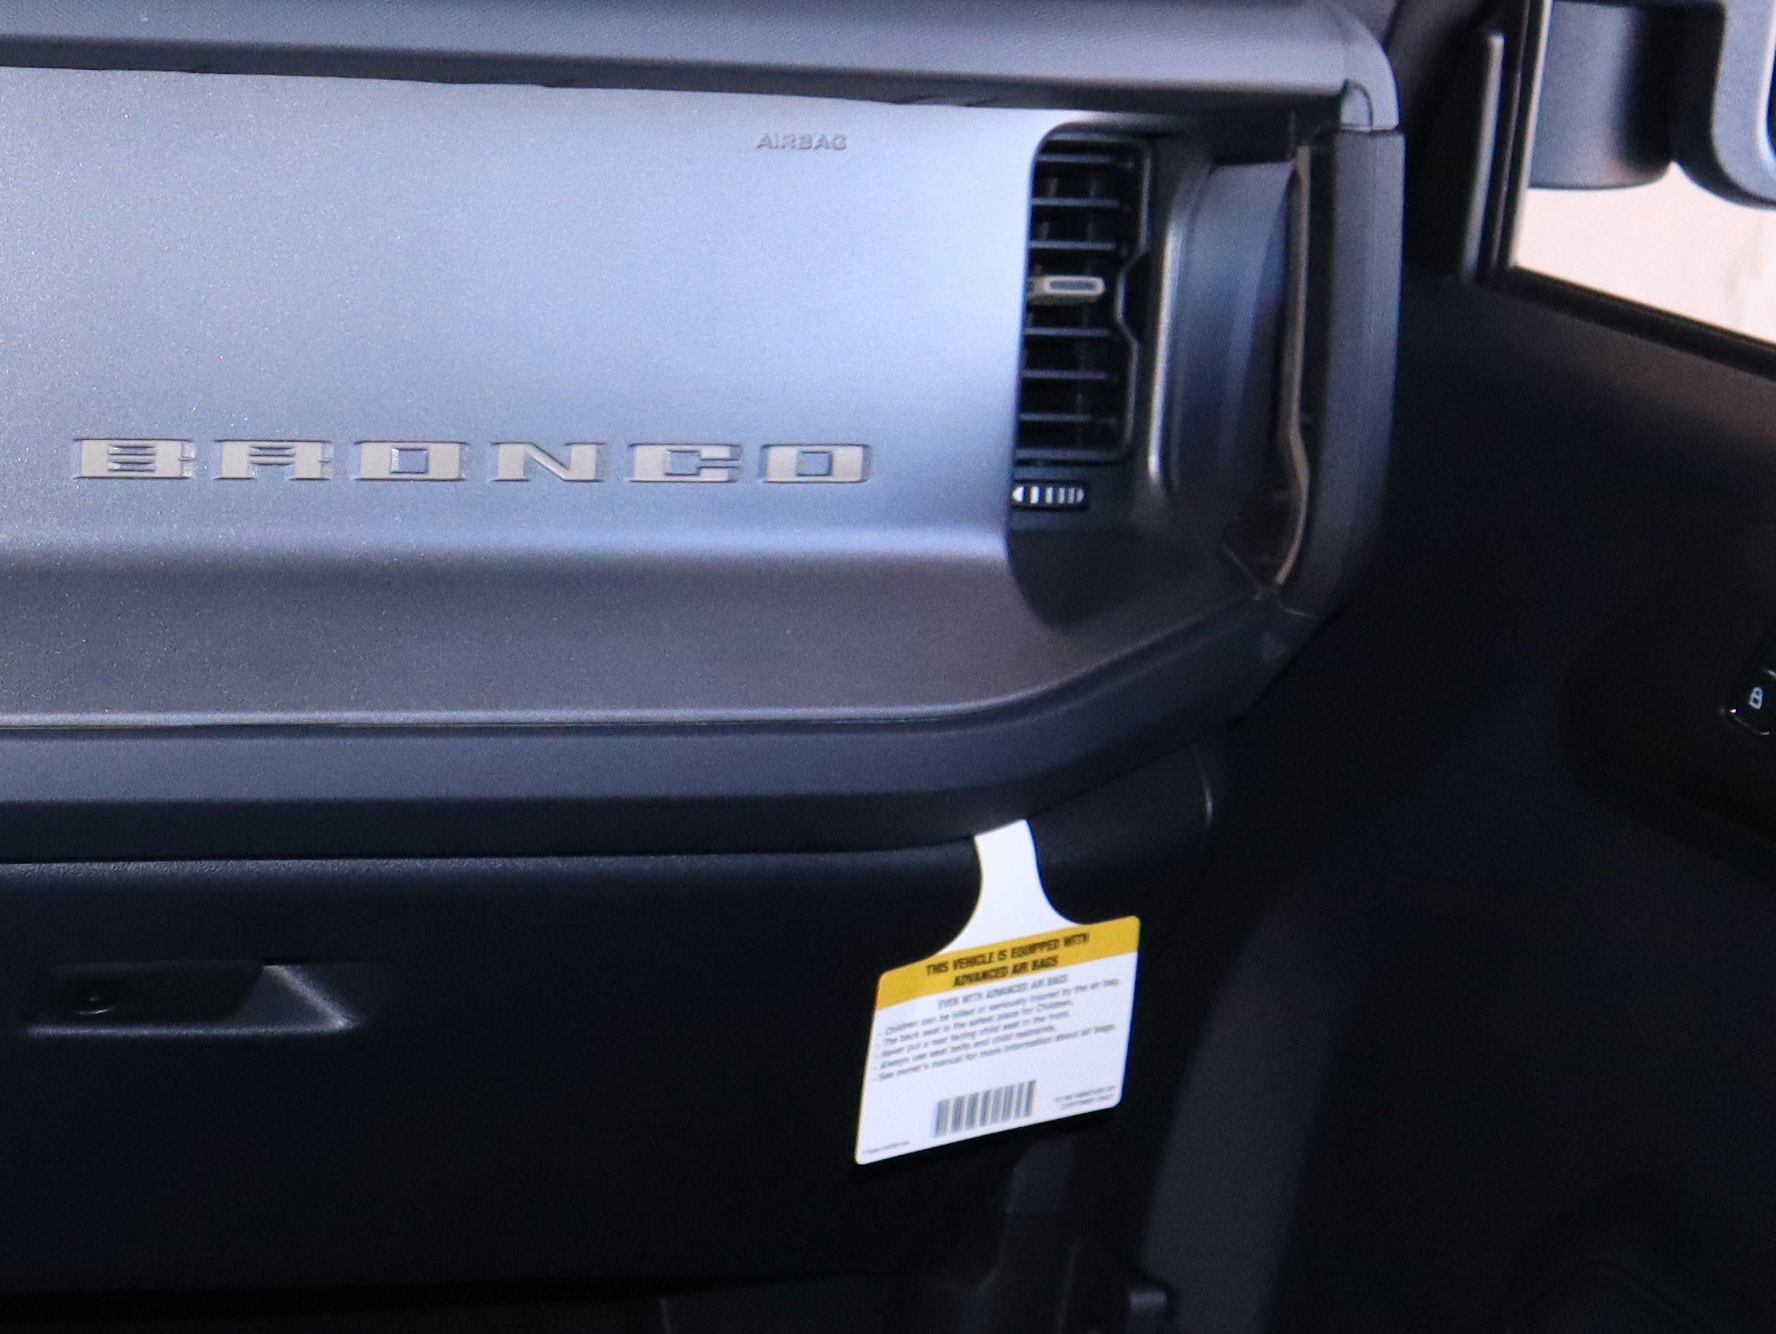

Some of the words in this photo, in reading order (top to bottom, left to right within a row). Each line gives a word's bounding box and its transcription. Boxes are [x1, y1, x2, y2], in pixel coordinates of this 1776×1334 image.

[756, 133, 847, 150] AIRBAG
[71, 438, 872, 483] BRONCO
[925, 962, 948, 976] THIS
[953, 952, 993, 970] VEHICLE
[997, 949, 1007, 960] IS
[1011, 938, 1059, 957] EQUIPPED
[1064, 932, 1090, 946] WITH
[954, 966, 1008, 986] ADVANCED
[1012, 961, 1028, 974] AIR
[1032, 955, 1059, 969] BAGS
